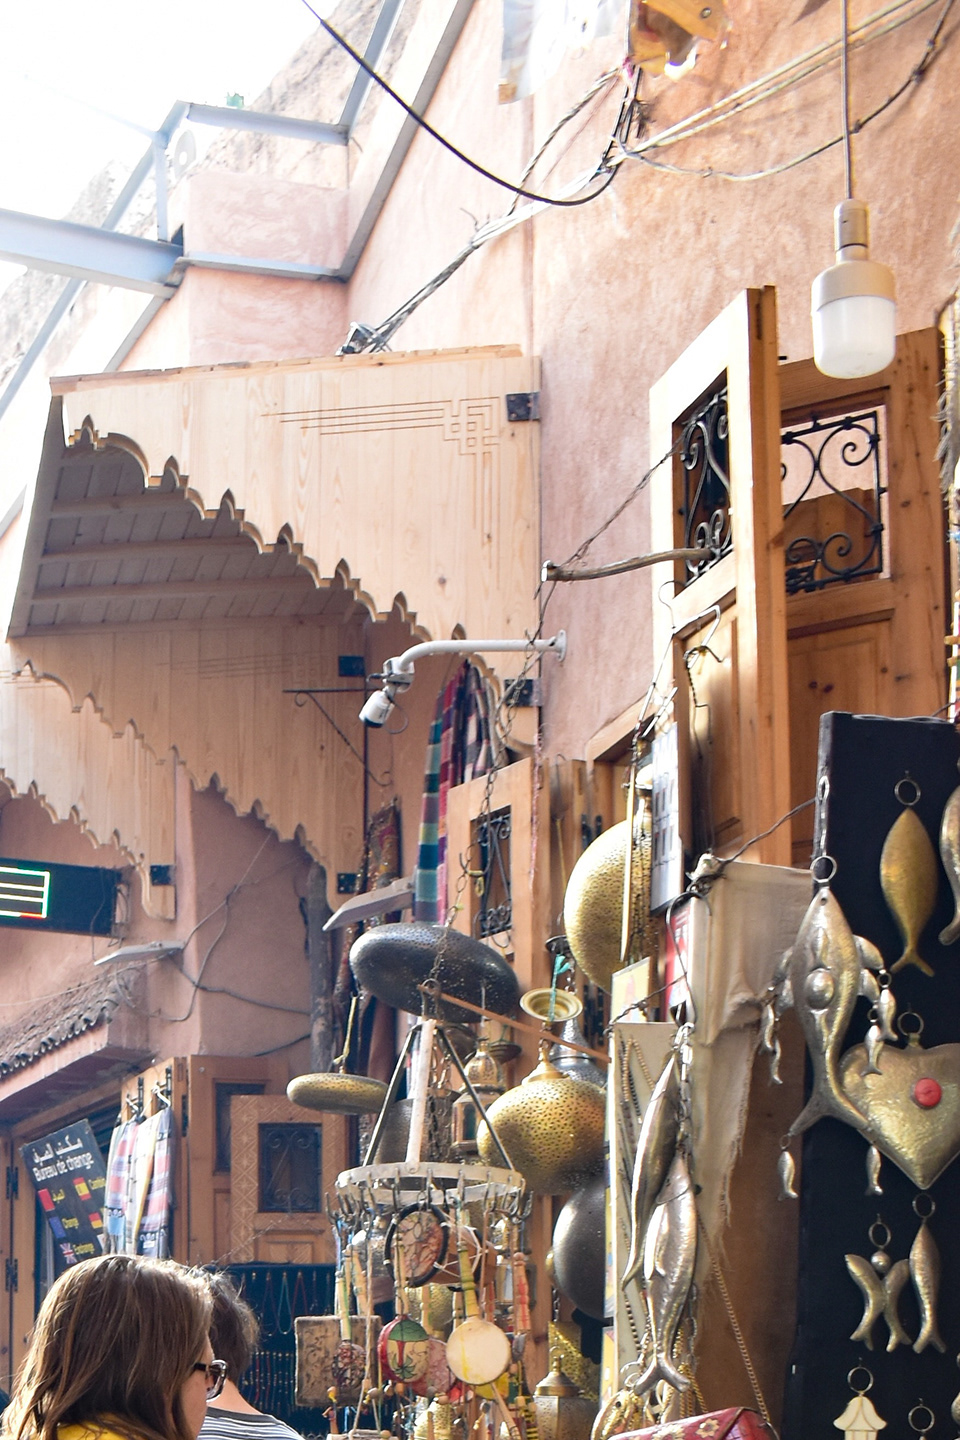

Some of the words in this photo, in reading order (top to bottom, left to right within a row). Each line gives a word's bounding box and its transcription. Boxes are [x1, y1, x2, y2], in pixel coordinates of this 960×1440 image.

[32, 1164, 58, 1182] Bureau
[56, 1160, 68, 1174] de
[66, 1152, 94, 1170] change
